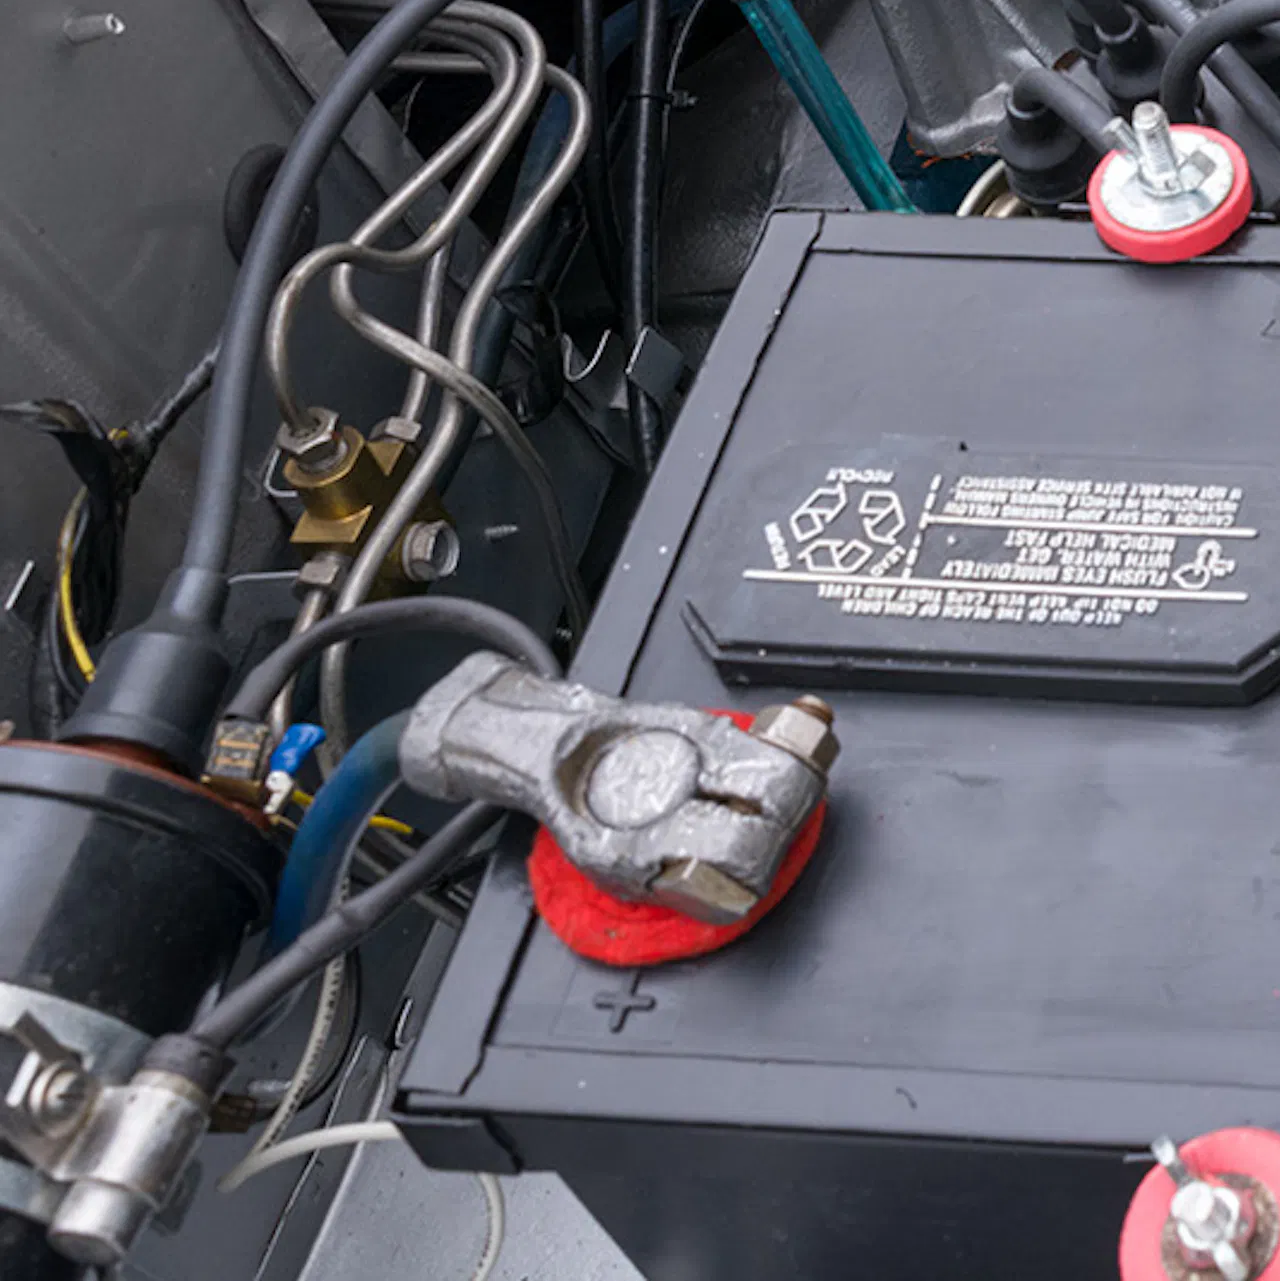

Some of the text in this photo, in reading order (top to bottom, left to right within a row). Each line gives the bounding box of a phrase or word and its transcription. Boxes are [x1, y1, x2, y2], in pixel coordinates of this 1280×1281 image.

[1004, 529, 1176, 552] MEDICAL HELP FAST
[870, 545, 906, 578] LEAD
[1015, 547, 1052, 564] GET
[1124, 552, 1171, 569] WITH
[941, 560, 1168, 587] FLUSH EYES IMMEDIATELY
[817, 584, 861, 598] LEVEL
[841, 600, 918, 617] CHILDREN
